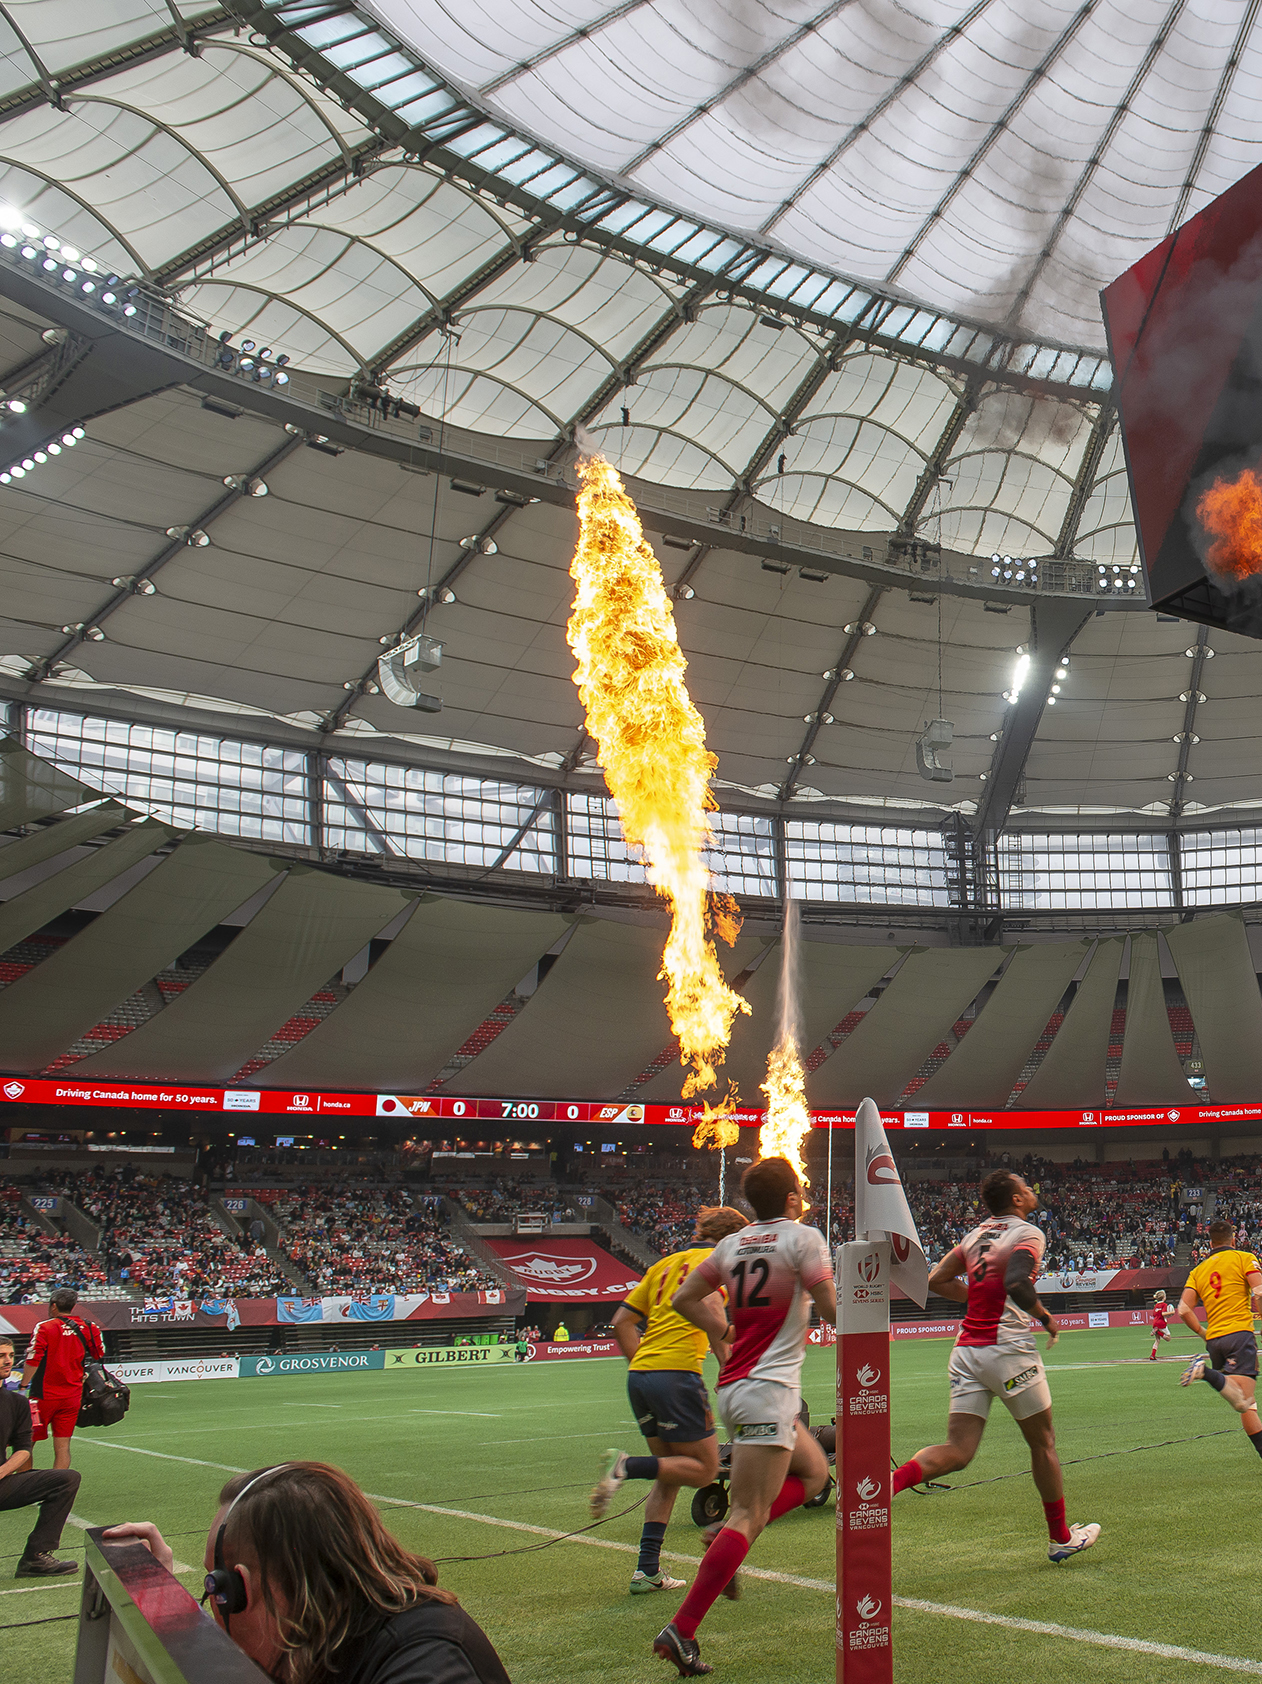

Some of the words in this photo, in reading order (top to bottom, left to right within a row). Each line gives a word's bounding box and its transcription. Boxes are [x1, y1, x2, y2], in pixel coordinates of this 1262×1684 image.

[56, 1088, 91, 1100] Driving
[93, 1090, 129, 1101] Canada
[131, 1091, 157, 1101] home
[159, 1092, 174, 1102] for
[175, 1094, 188, 1103] 50
[189, 1095, 218, 1105] years.
[323, 1101, 351, 1109] honda.ca
[409, 1101, 431, 1113] JPN
[453, 1101, 465, 1115] 0
[501, 1102, 539, 1118] 7:00
[567, 1105, 579, 1119] 0
[599, 1107, 619, 1119] ESP
[1126, 1113, 1155, 1121] SPONSOR
[1199, 1110, 1220, 1119] Driving
[1221, 1108, 1243, 1117] Canada
[1244, 1107, 1261, 1115] home
[817, 1116, 842, 1124] Canada
[843, 1116, 856, 1124] hom
[1189, 1189, 1200, 1197] 233
[34, 1199, 53, 1209] 225
[227, 1200, 243, 1209] 226
[578, 1197, 592, 1206] 228
[974, 1245, 991, 1282] 5
[524, 1268, 573, 1276] RUGBY
[730, 1258, 772, 1308] 12
[1209, 1272, 1222, 1299] 9
[131, 1314, 158, 1323] HITS
[160, 1313, 196, 1322] TOWN
[1069, 1318, 1085, 1327] years.
[896, 1327, 917, 1335] PROUD
[547, 1344, 592, 1355] Empowering
[415, 1348, 491, 1364] GILBERT
[279, 1355, 369, 1371] GROSVENOR
[167, 1363, 233, 1375] VANCOUVER
[849, 1395, 888, 1404] CANADA
[849, 1402, 888, 1411] SEVENS
[850, 1408, 888, 1416] VANCOUVER
[849, 1508, 888, 1518] CANADA
[849, 1515, 888, 1526] SEVENS
[850, 1523, 888, 1531] VANCOUVER
[849, 1627, 888, 1638] CANADA
[849, 1634, 888, 1646] SEVENS
[850, 1642, 888, 1651] VANCOUVER
